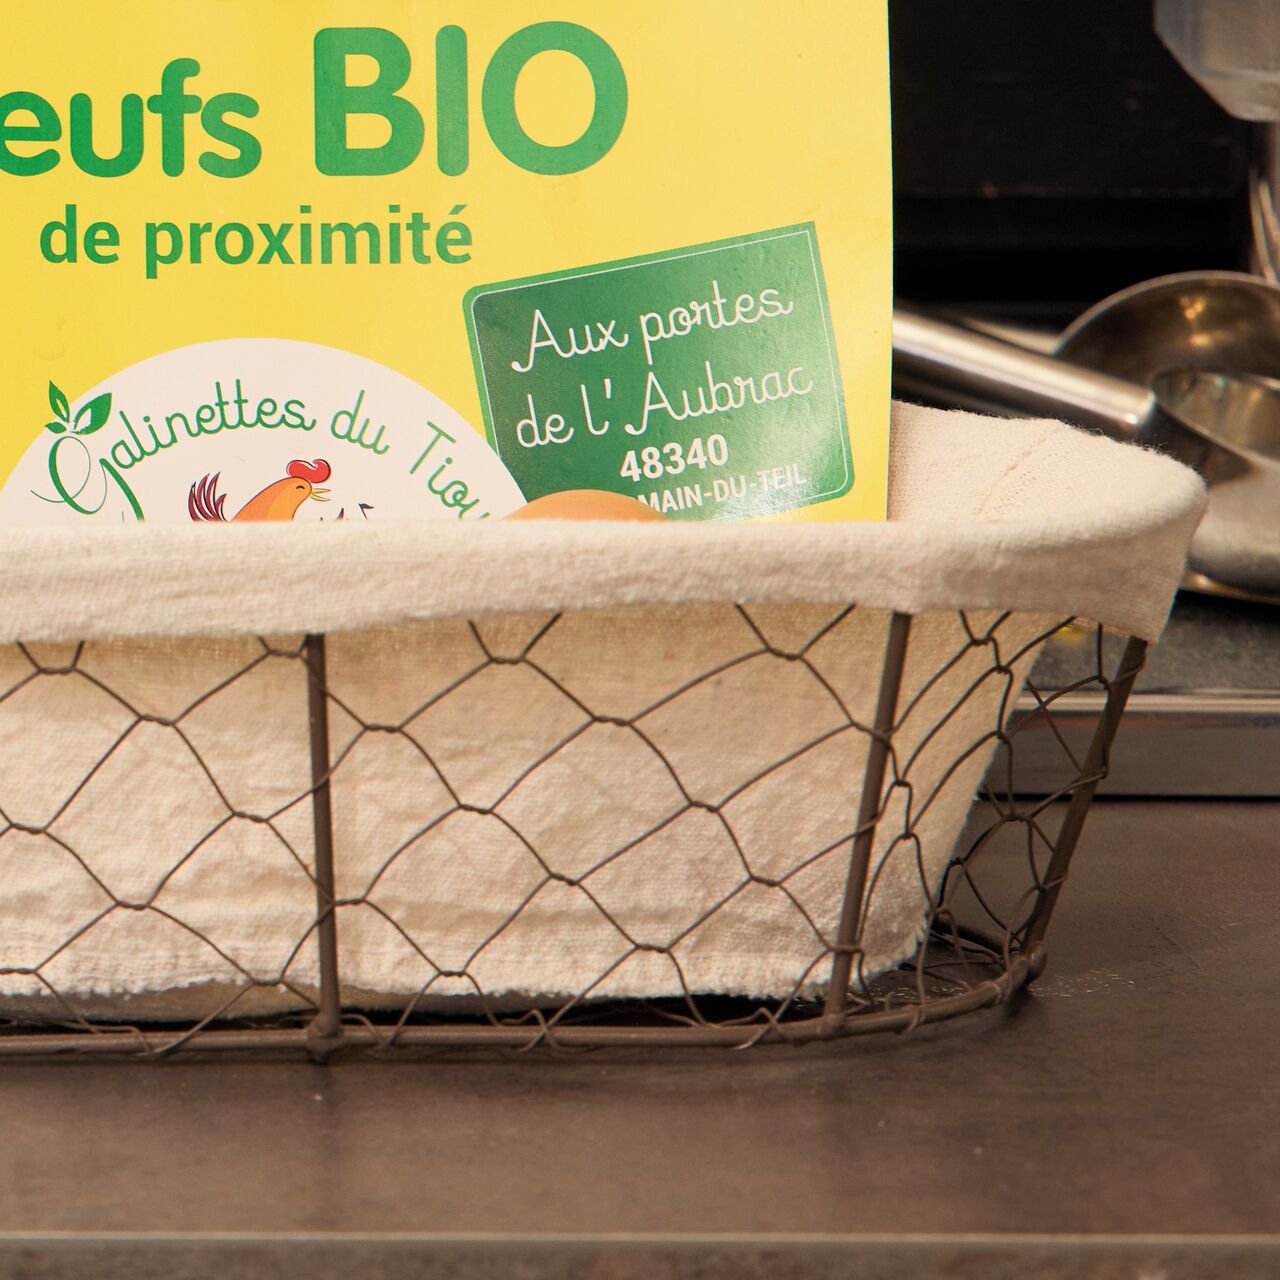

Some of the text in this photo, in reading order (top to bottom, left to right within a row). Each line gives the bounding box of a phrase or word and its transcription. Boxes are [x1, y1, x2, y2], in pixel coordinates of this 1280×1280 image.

[313, 21, 629, 177] BIO
[40, 204, 473, 279] de proximité
[511, 280, 794, 373] Aux portes
[330, 389, 390, 455] du
[516, 394, 574, 448] de
[620, 434, 729, 482] 48340
